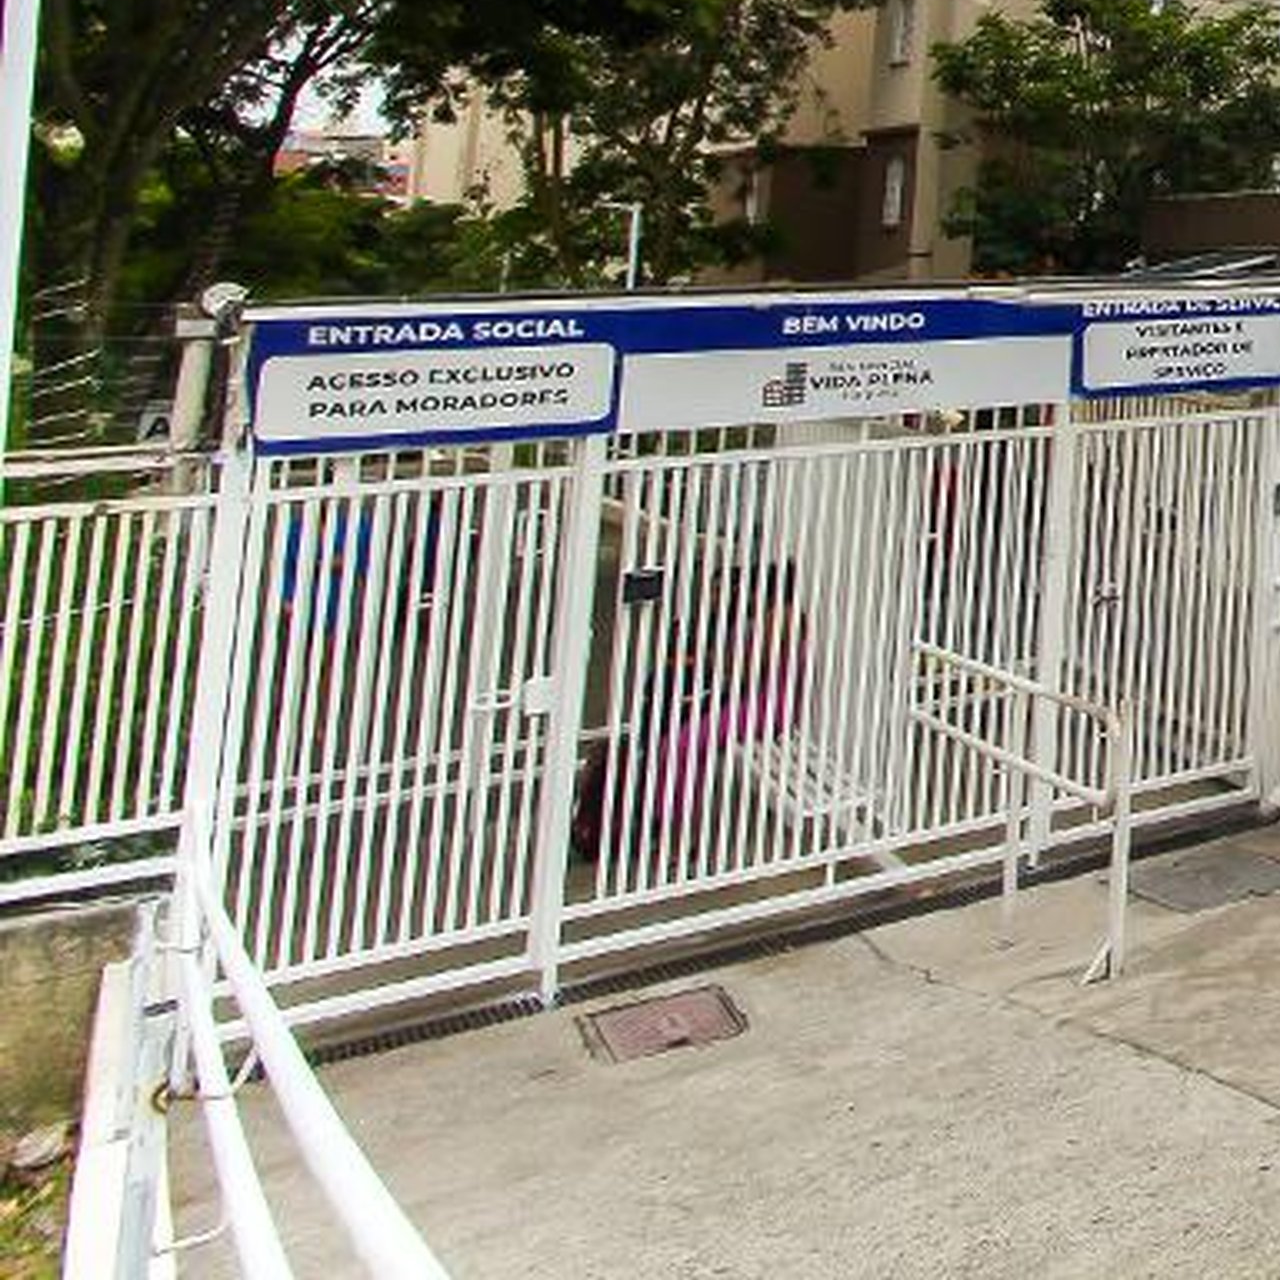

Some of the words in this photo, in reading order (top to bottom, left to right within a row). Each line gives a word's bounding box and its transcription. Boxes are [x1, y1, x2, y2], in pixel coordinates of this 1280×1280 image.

[1082, 299, 1181, 318] ENTRADA
[307, 320, 464, 347] ENTRADA
[472, 318, 585, 340] SOCIAL
[782, 315, 838, 334] BEM
[845, 312, 926, 332] VINDO
[1136, 322, 1231, 338] VISITANTES
[306, 369, 420, 391] ACESSO
[428, 361, 575, 384] EXCLUSIVO
[809, 375, 862, 390] VIDA
[308, 400, 388, 419] PARA
[395, 388, 568, 412] MORADORES
